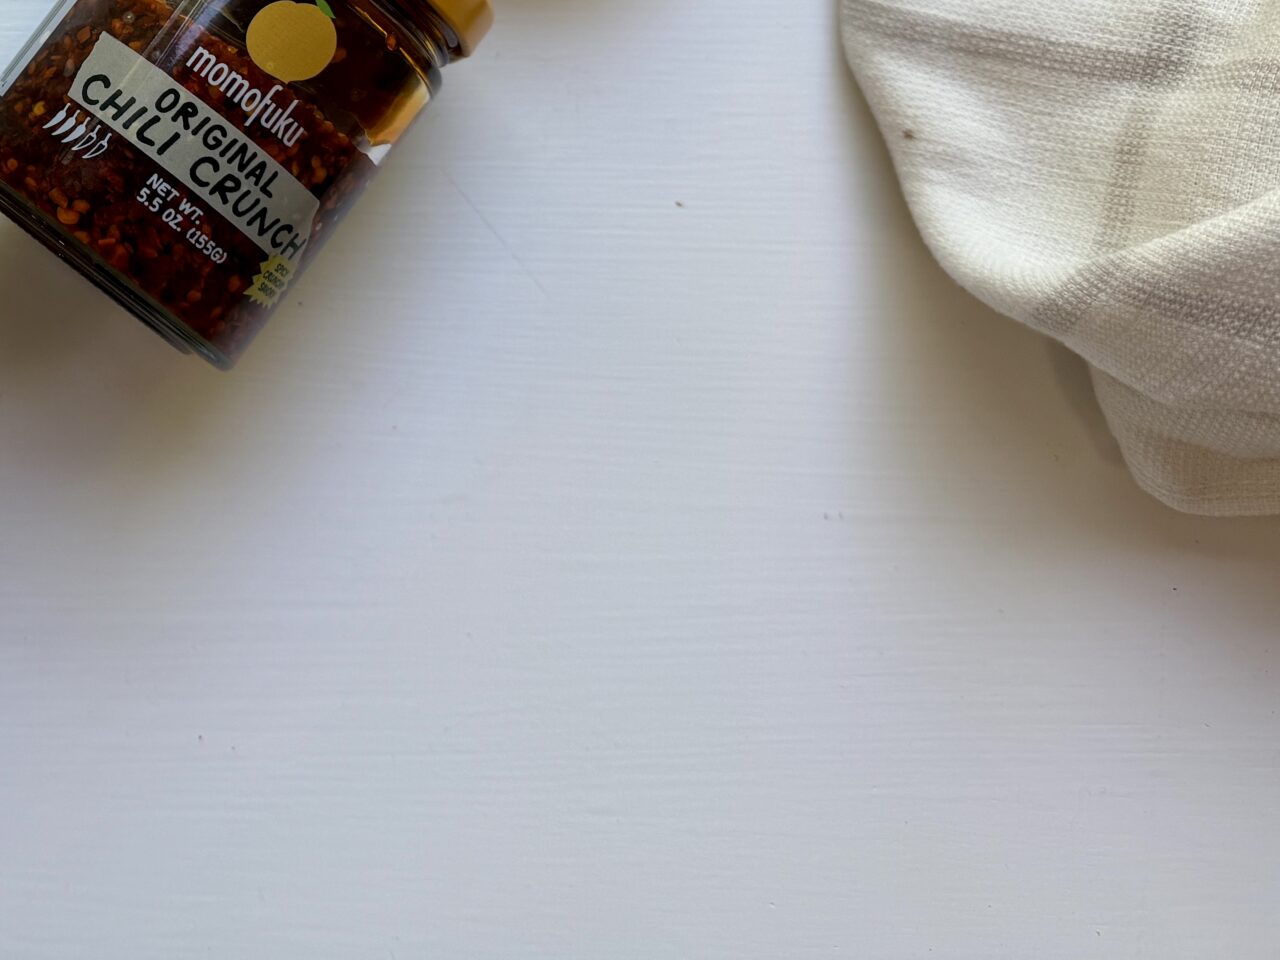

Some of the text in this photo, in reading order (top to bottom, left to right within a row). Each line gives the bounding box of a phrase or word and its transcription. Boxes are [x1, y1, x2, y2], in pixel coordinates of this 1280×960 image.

[155, 88, 279, 198] ORIGINAL
[186, 46, 305, 148] momofuku
[81, 74, 306, 259] CHILI CRUNCH
[146, 173, 202, 224] NET WT.
[136, 189, 227, 264] 5.5 OZ. (155G)
